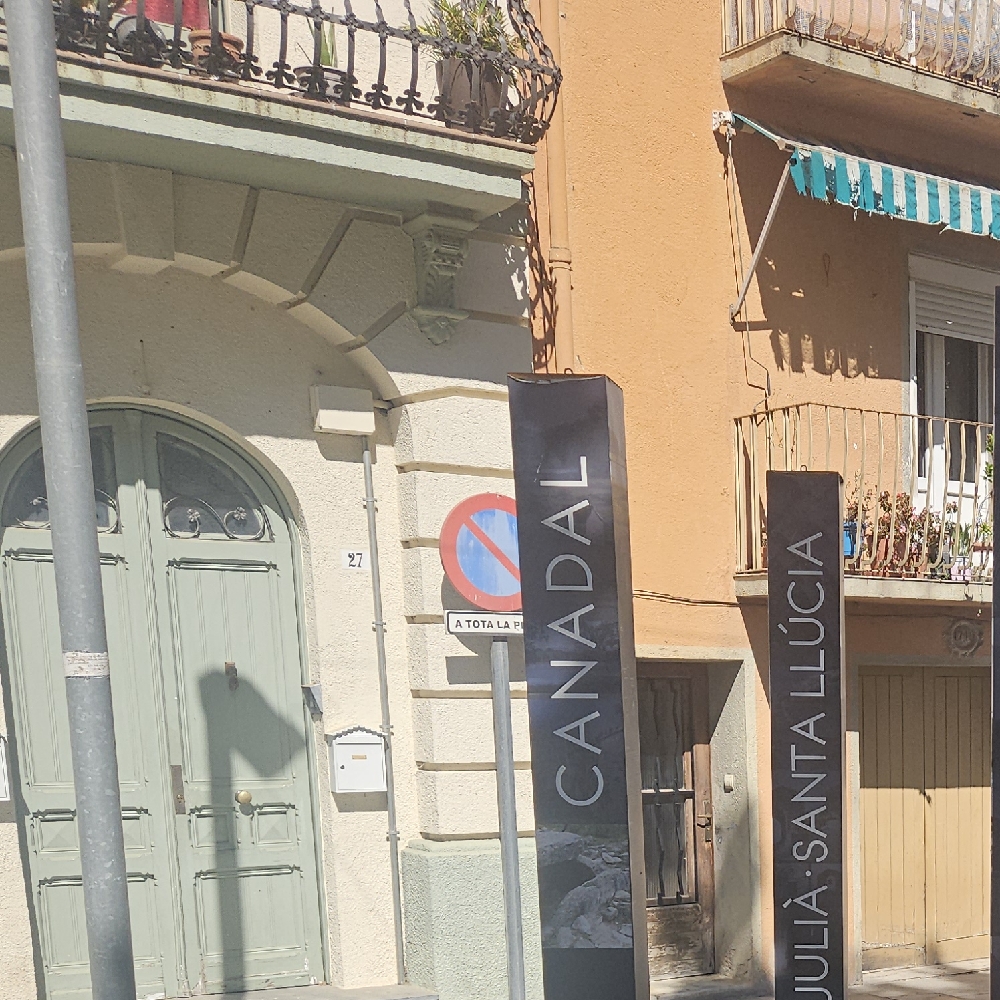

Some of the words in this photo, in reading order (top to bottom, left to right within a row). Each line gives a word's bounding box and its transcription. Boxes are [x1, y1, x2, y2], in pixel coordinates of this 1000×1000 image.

[347, 552, 363, 568] 27
[454, 619, 463, 629] A
[465, 619, 494, 629] TOTA
[497, 620, 511, 630] LA
[539, 455, 605, 807] CANADAL
[777, 531, 825, 698] LLÚCIA
